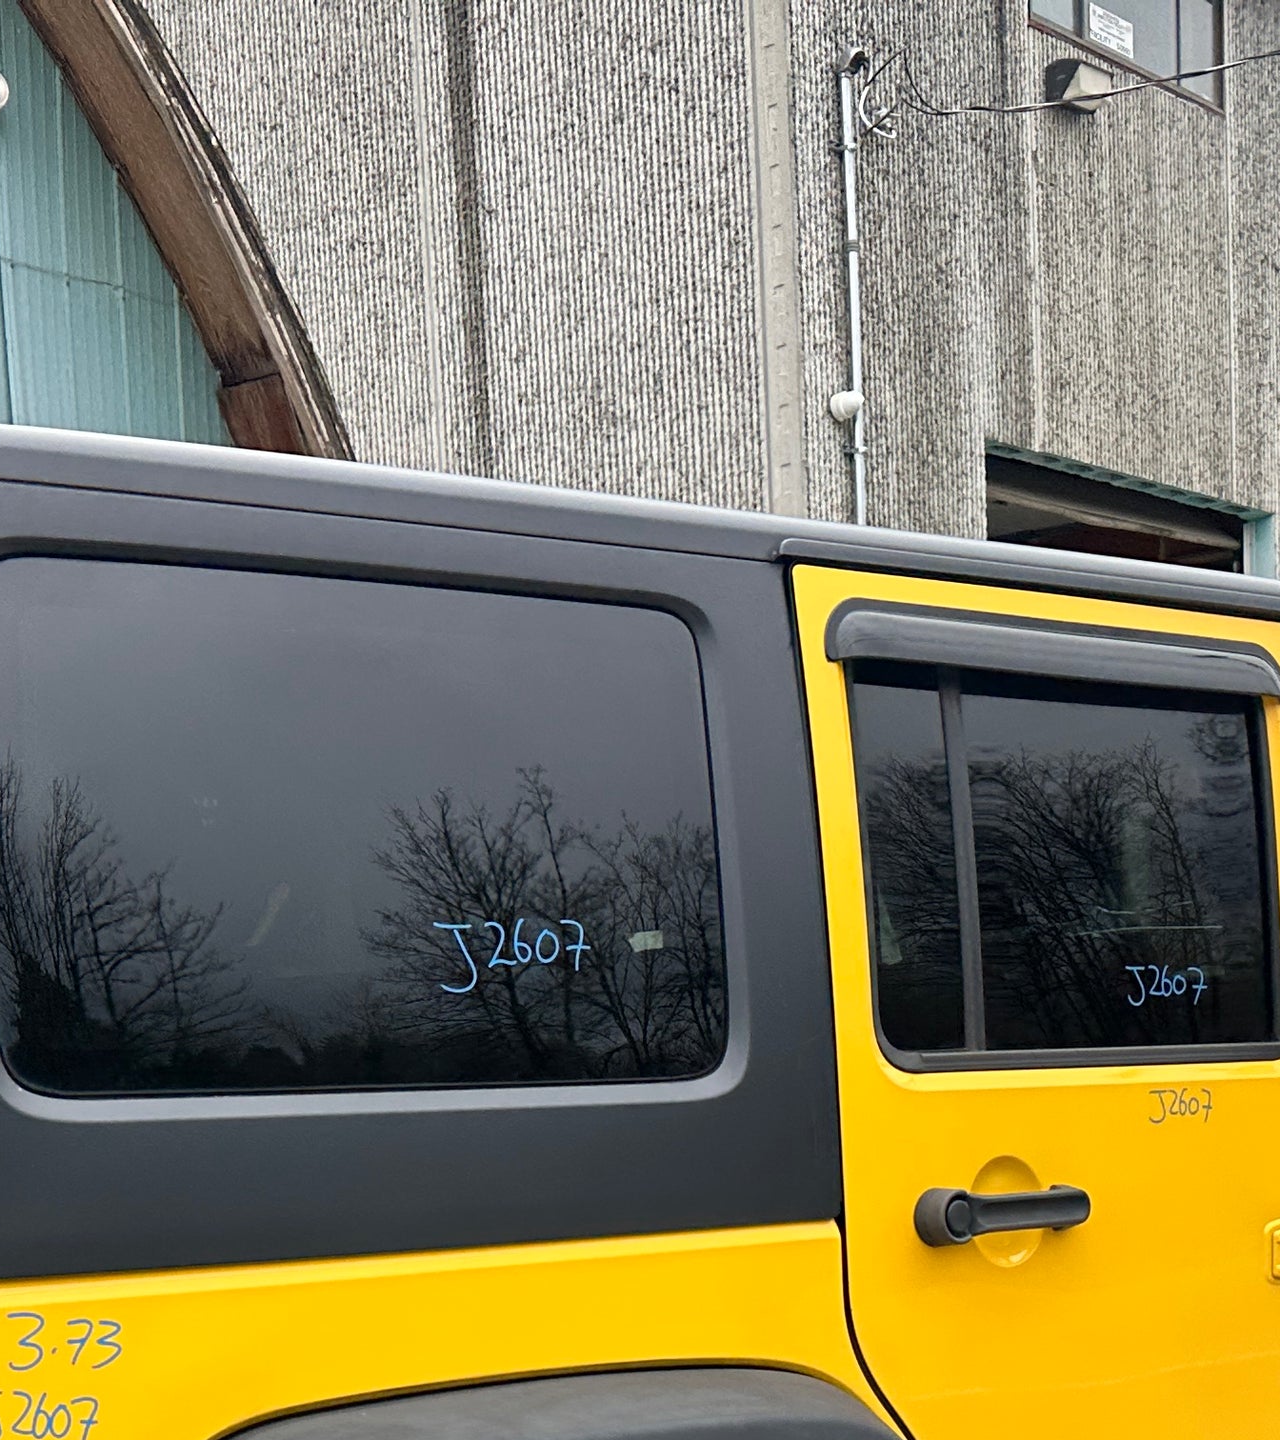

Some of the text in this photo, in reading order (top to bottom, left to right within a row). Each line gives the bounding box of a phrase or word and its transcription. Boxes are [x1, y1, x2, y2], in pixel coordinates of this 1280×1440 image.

[433, 918, 591, 993] J2607
[1124, 964, 1209, 1007] J2607
[1148, 1088, 1213, 1124] J2607
[6, 1311, 123, 1372] 3.73
